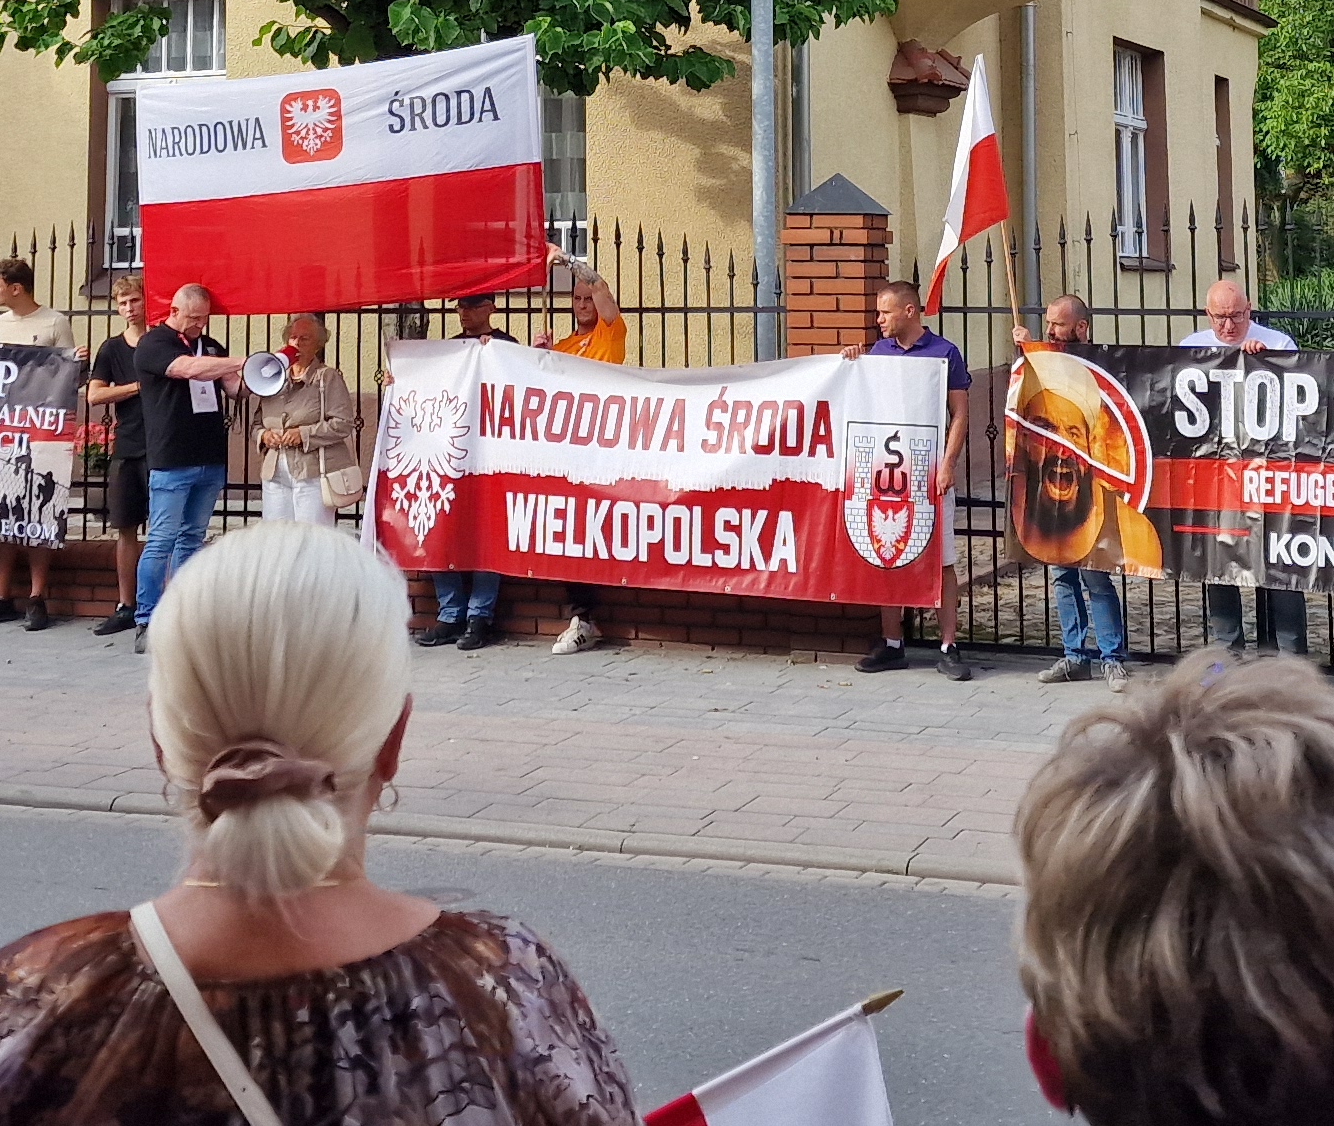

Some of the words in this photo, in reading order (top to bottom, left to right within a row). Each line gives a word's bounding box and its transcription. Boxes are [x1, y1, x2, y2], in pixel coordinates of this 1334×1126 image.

[147, 117, 268, 160] NARODOWA
[387, 86, 501, 135] ŚRODA
[479, 382, 686, 452] NARODOWA
[700, 386, 835, 459] ŚRODA
[1173, 368, 1319, 442] STOP
[506, 492, 797, 573] WIELKOPOLSKA
